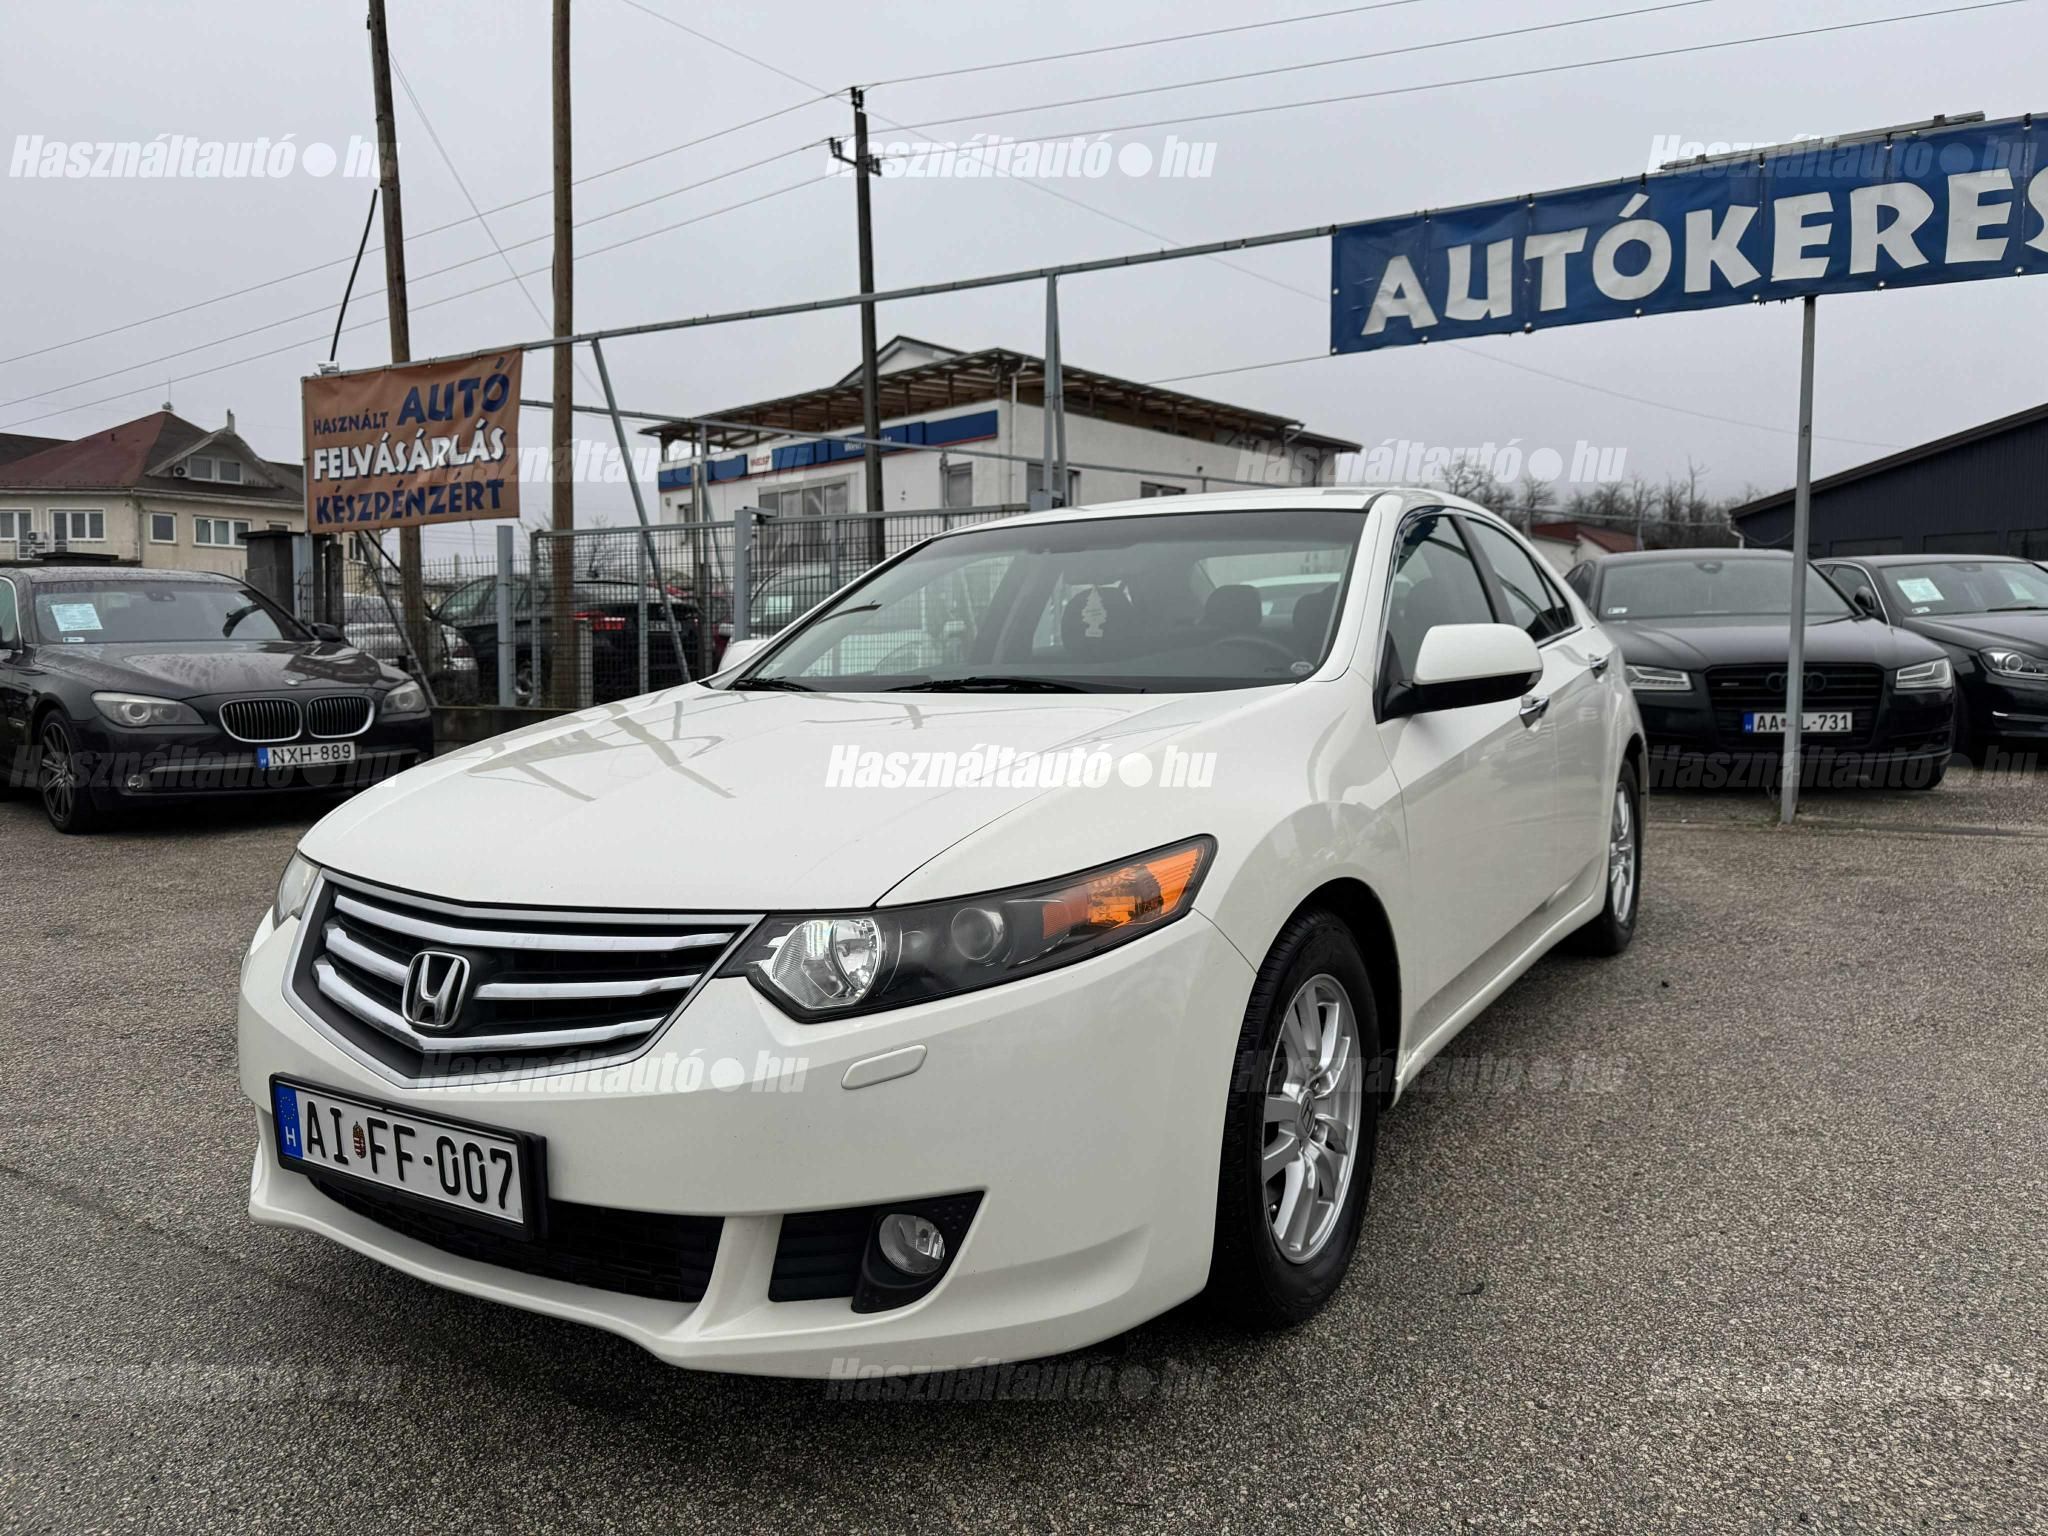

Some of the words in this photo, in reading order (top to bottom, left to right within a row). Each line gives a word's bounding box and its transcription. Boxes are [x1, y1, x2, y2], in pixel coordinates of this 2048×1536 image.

[313, 408, 389, 436] HASZNÁLT
[397, 356, 510, 426] AUTÓ
[313, 418, 506, 480] FELVÁSÁRLÁS
[316, 472, 505, 525] KÉSZPÉNZÉRT
[272, 743, 351, 765] NXH-889
